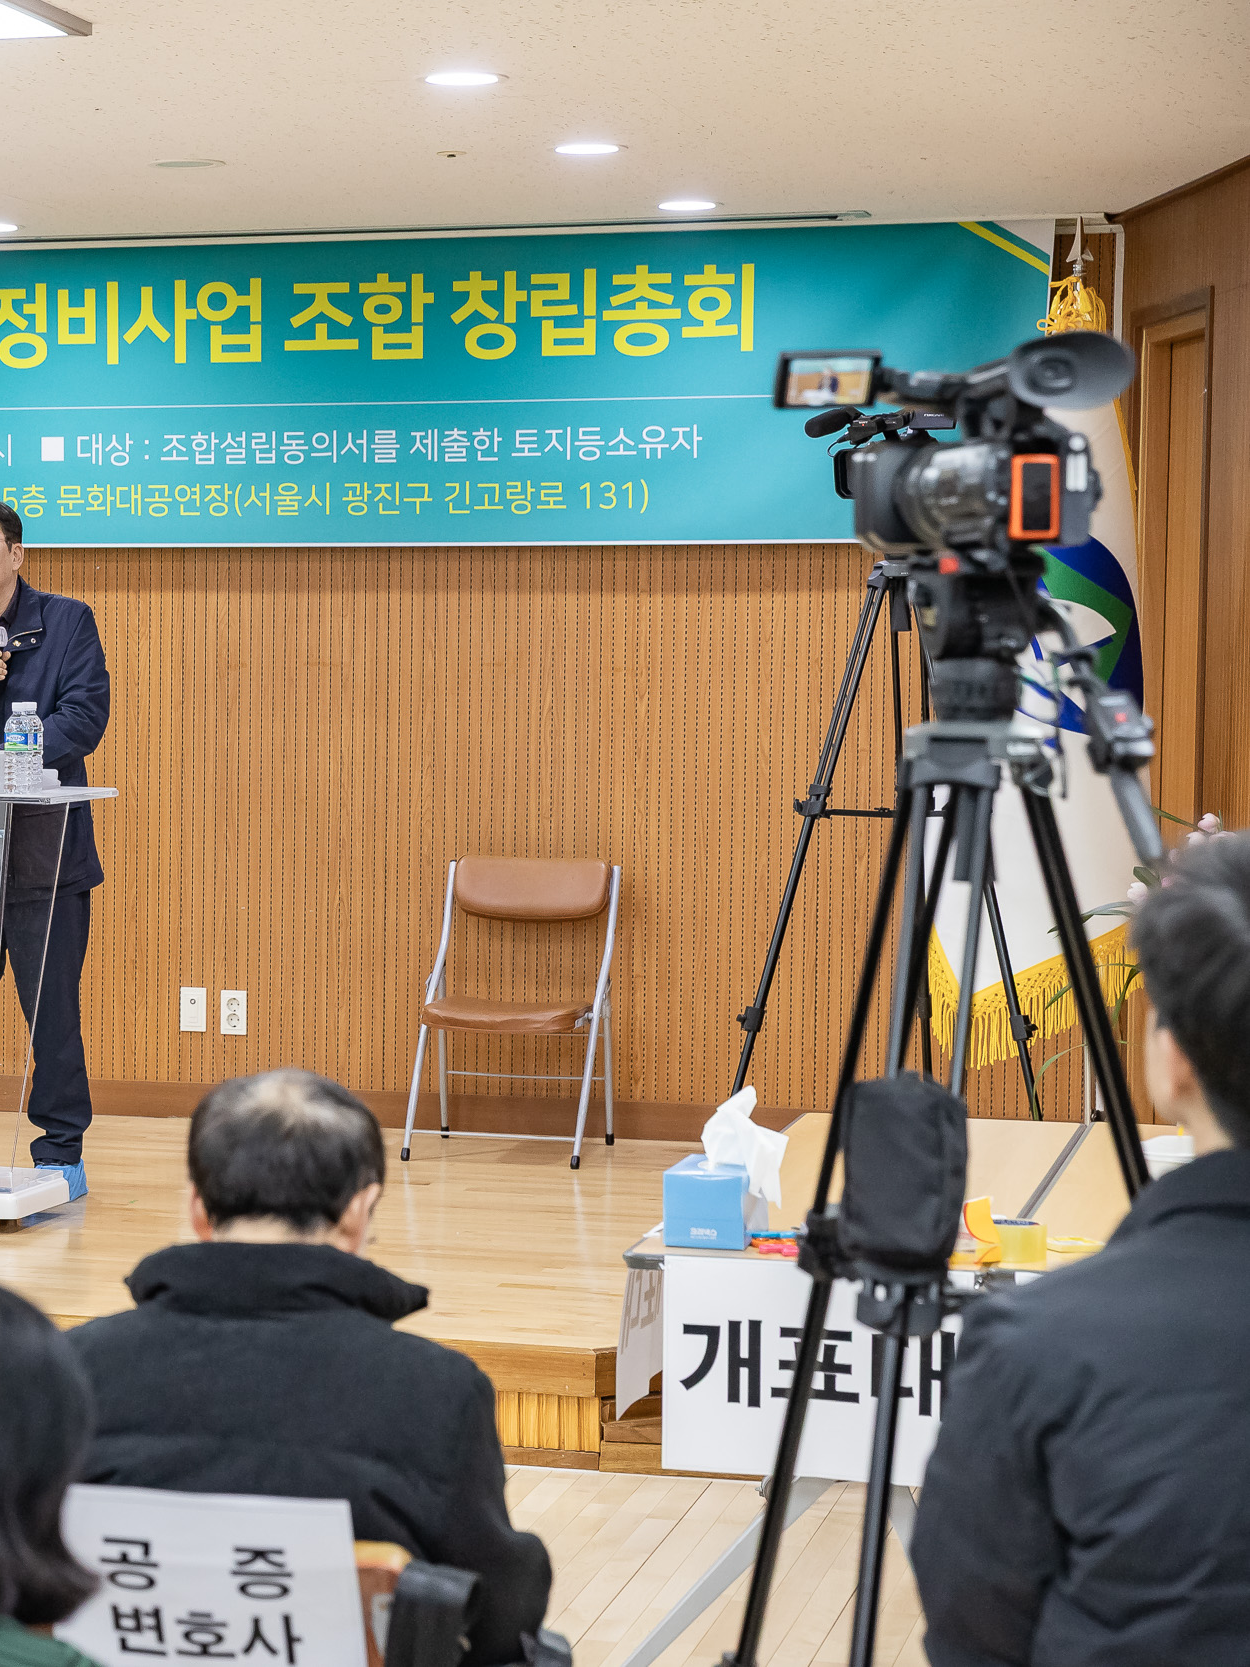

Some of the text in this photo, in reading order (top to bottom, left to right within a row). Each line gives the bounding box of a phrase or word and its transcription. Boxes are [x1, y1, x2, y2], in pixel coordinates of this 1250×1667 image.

[284, 273, 435, 360] 조합
[450, 263, 756, 360] 창립총회
[76, 431, 134, 467] 대상
[160, 429, 400, 465] 조합설립동의서를
[409, 427, 503, 463] 제출한
[511, 423, 703, 461] 토지등소유자
[2, 483, 48, 518] 5층
[56, 482, 330, 518] 문화대공연장(서울시
[341, 481, 433, 516] 광진구
[444, 479, 567, 515] 긴고랑로
[579, 478, 649, 514] 131)
[110, 1603, 303, 1666] 변호사
